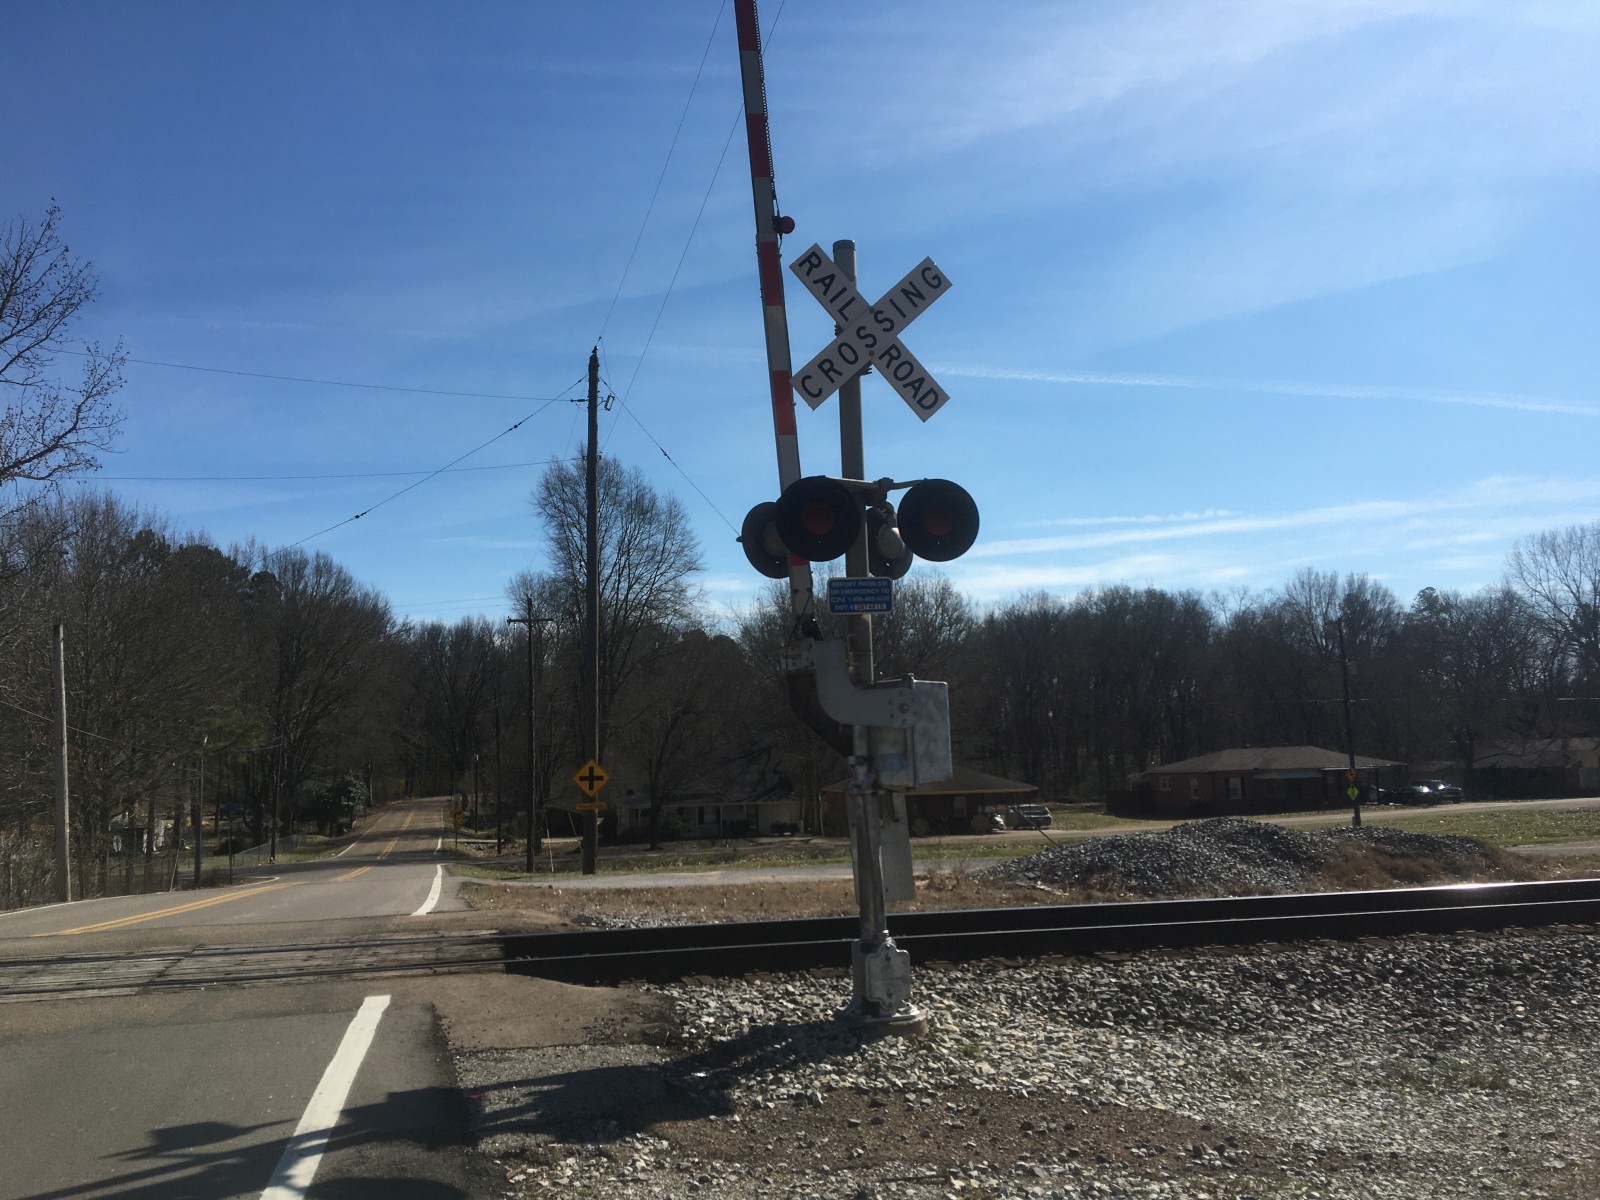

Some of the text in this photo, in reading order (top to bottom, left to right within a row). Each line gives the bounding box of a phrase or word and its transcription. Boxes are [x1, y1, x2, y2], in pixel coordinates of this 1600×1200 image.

[798, 250, 939, 410] RAIL ROAD
[800, 266, 942, 399] CROSSING
